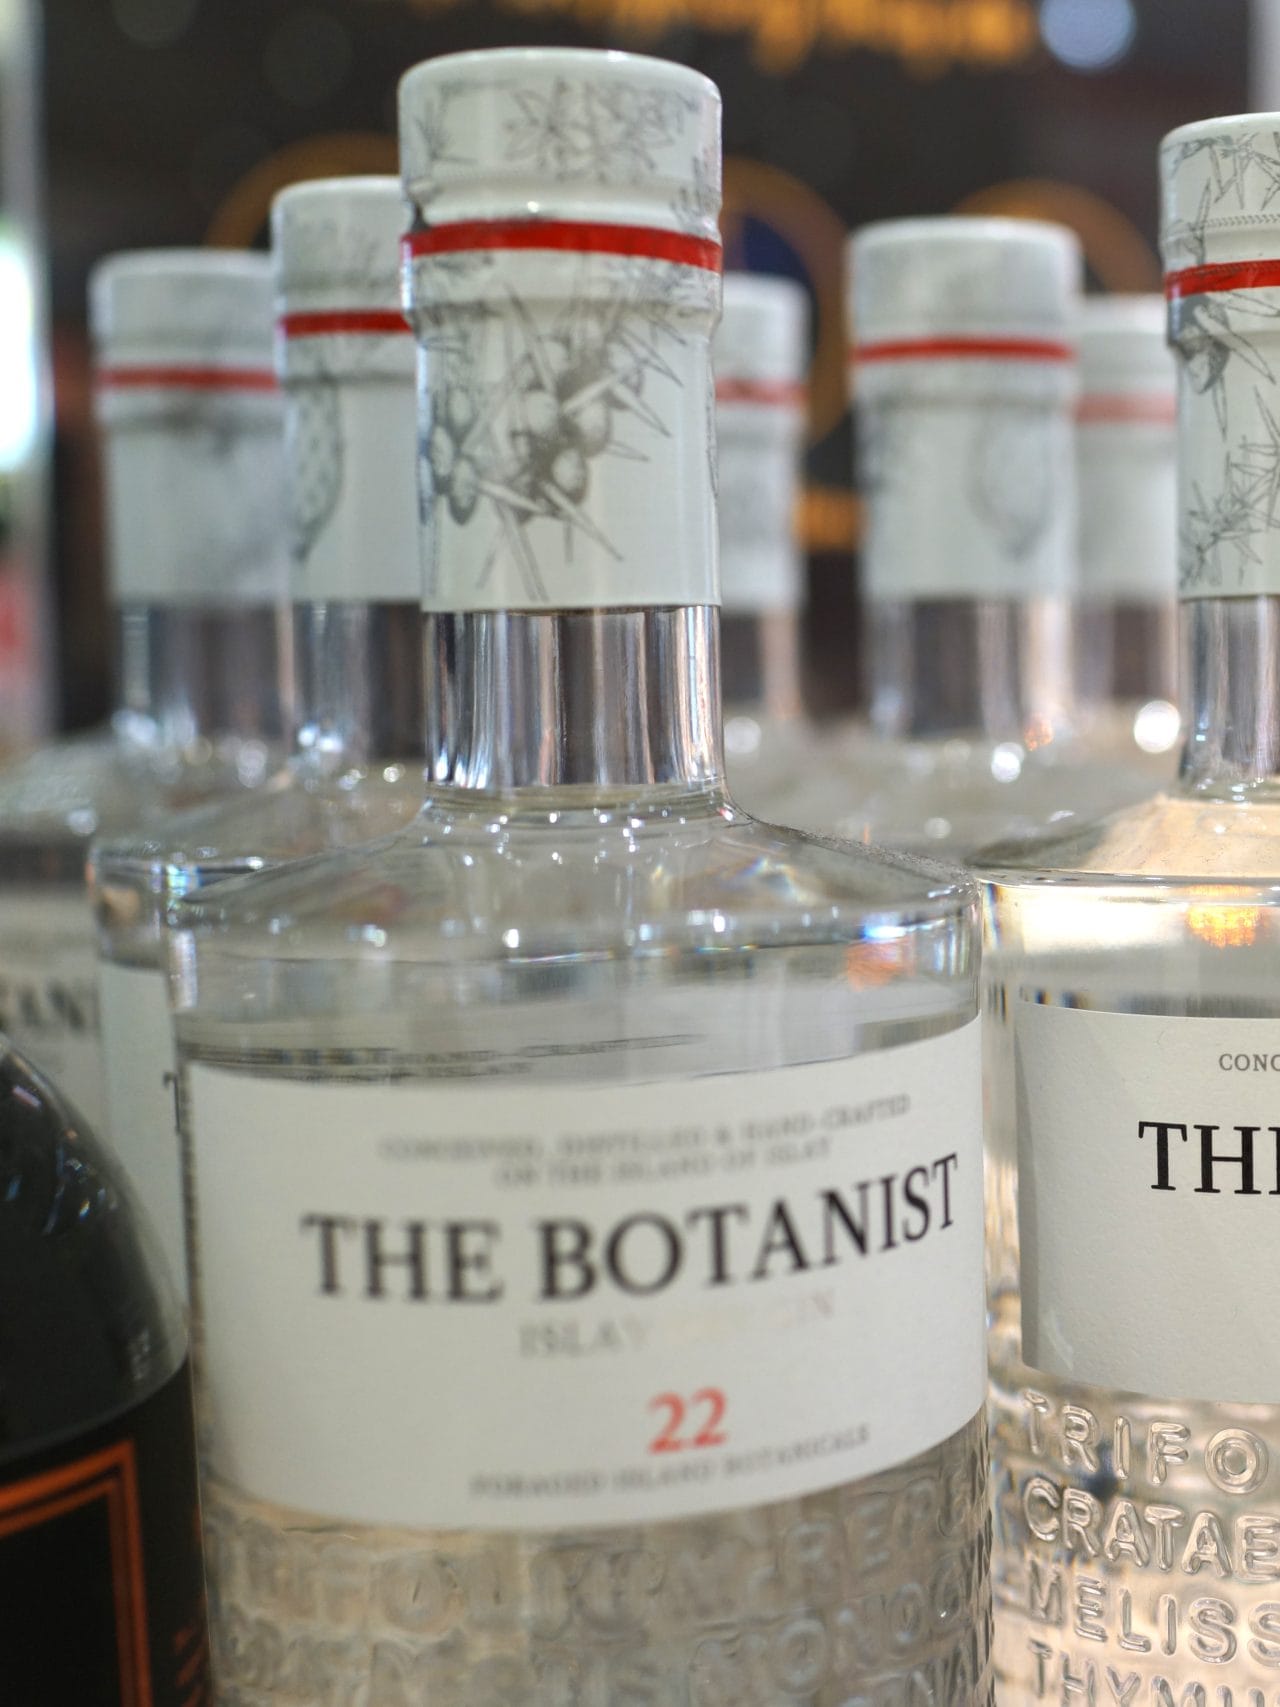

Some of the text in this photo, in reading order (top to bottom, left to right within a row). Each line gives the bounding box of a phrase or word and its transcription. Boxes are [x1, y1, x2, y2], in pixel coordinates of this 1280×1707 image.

[301, 1153, 960, 1302] THE BOTANIST
[649, 1387, 729, 1455] 22
